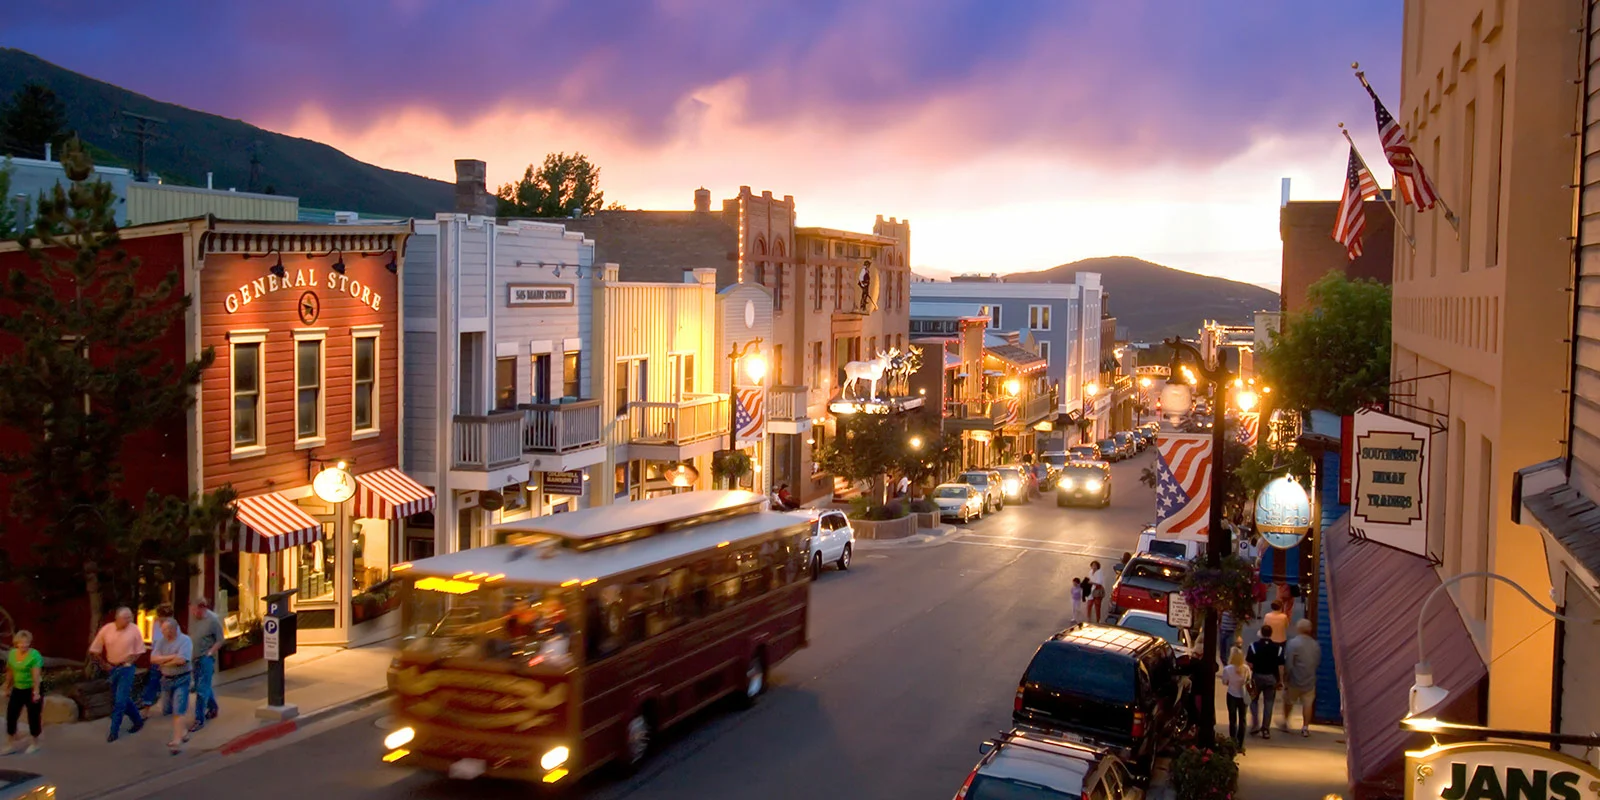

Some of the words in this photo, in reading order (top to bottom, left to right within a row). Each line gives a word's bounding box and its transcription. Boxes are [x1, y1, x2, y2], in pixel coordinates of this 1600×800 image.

[225, 269, 317, 314] GENERAL
[328, 272, 382, 312] STORE
[527, 290, 544, 300] MAIN
[545, 290, 567, 300] STREET
[1361, 447, 1419, 462] SOUTHWEST
[1367, 494, 1412, 509] TRADERS
[271, 603, 278, 614] P
[268, 621, 276, 633] P
[1440, 762, 1581, 800] JANS
